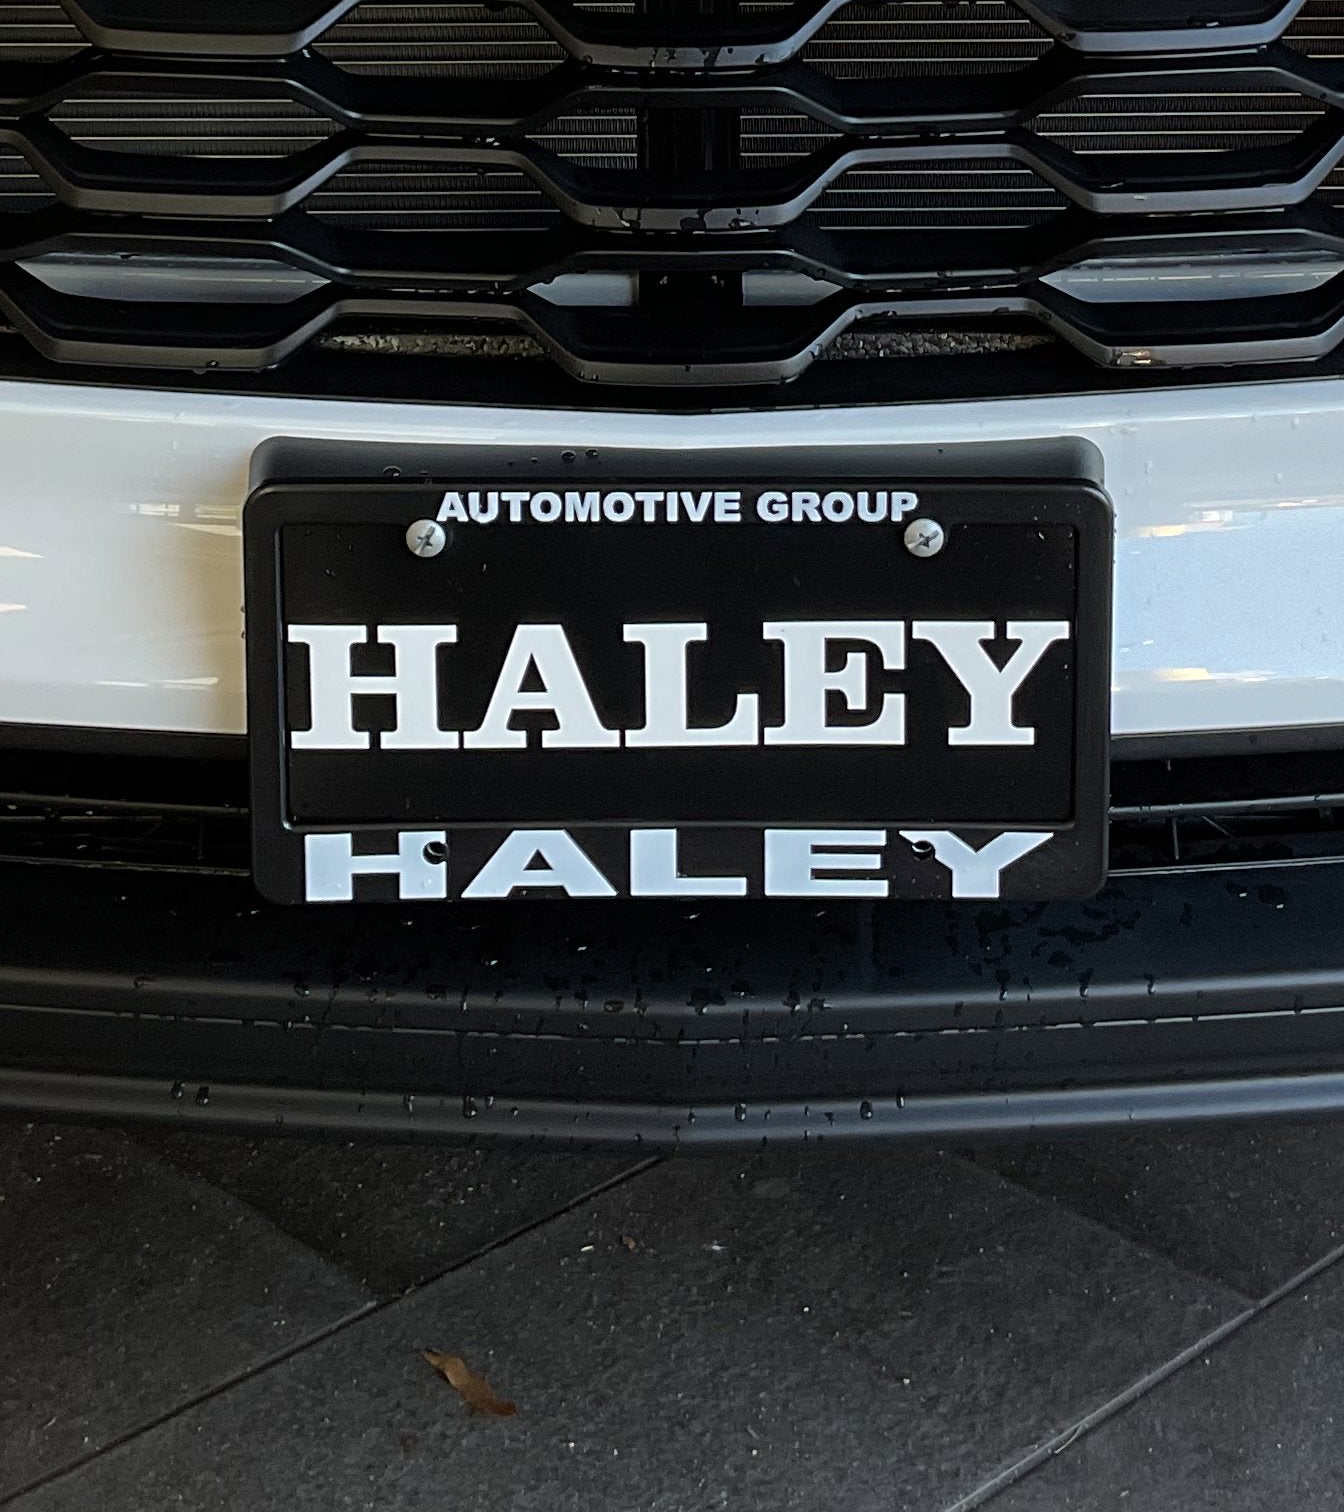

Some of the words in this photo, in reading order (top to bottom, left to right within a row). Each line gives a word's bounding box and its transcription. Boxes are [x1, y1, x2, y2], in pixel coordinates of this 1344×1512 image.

[436, 490, 742, 524] AUTOMOTIVE
[756, 490, 919, 524] GROUP
[287, 620, 1071, 751] HALEY
[303, 828, 1054, 902] HALEY
